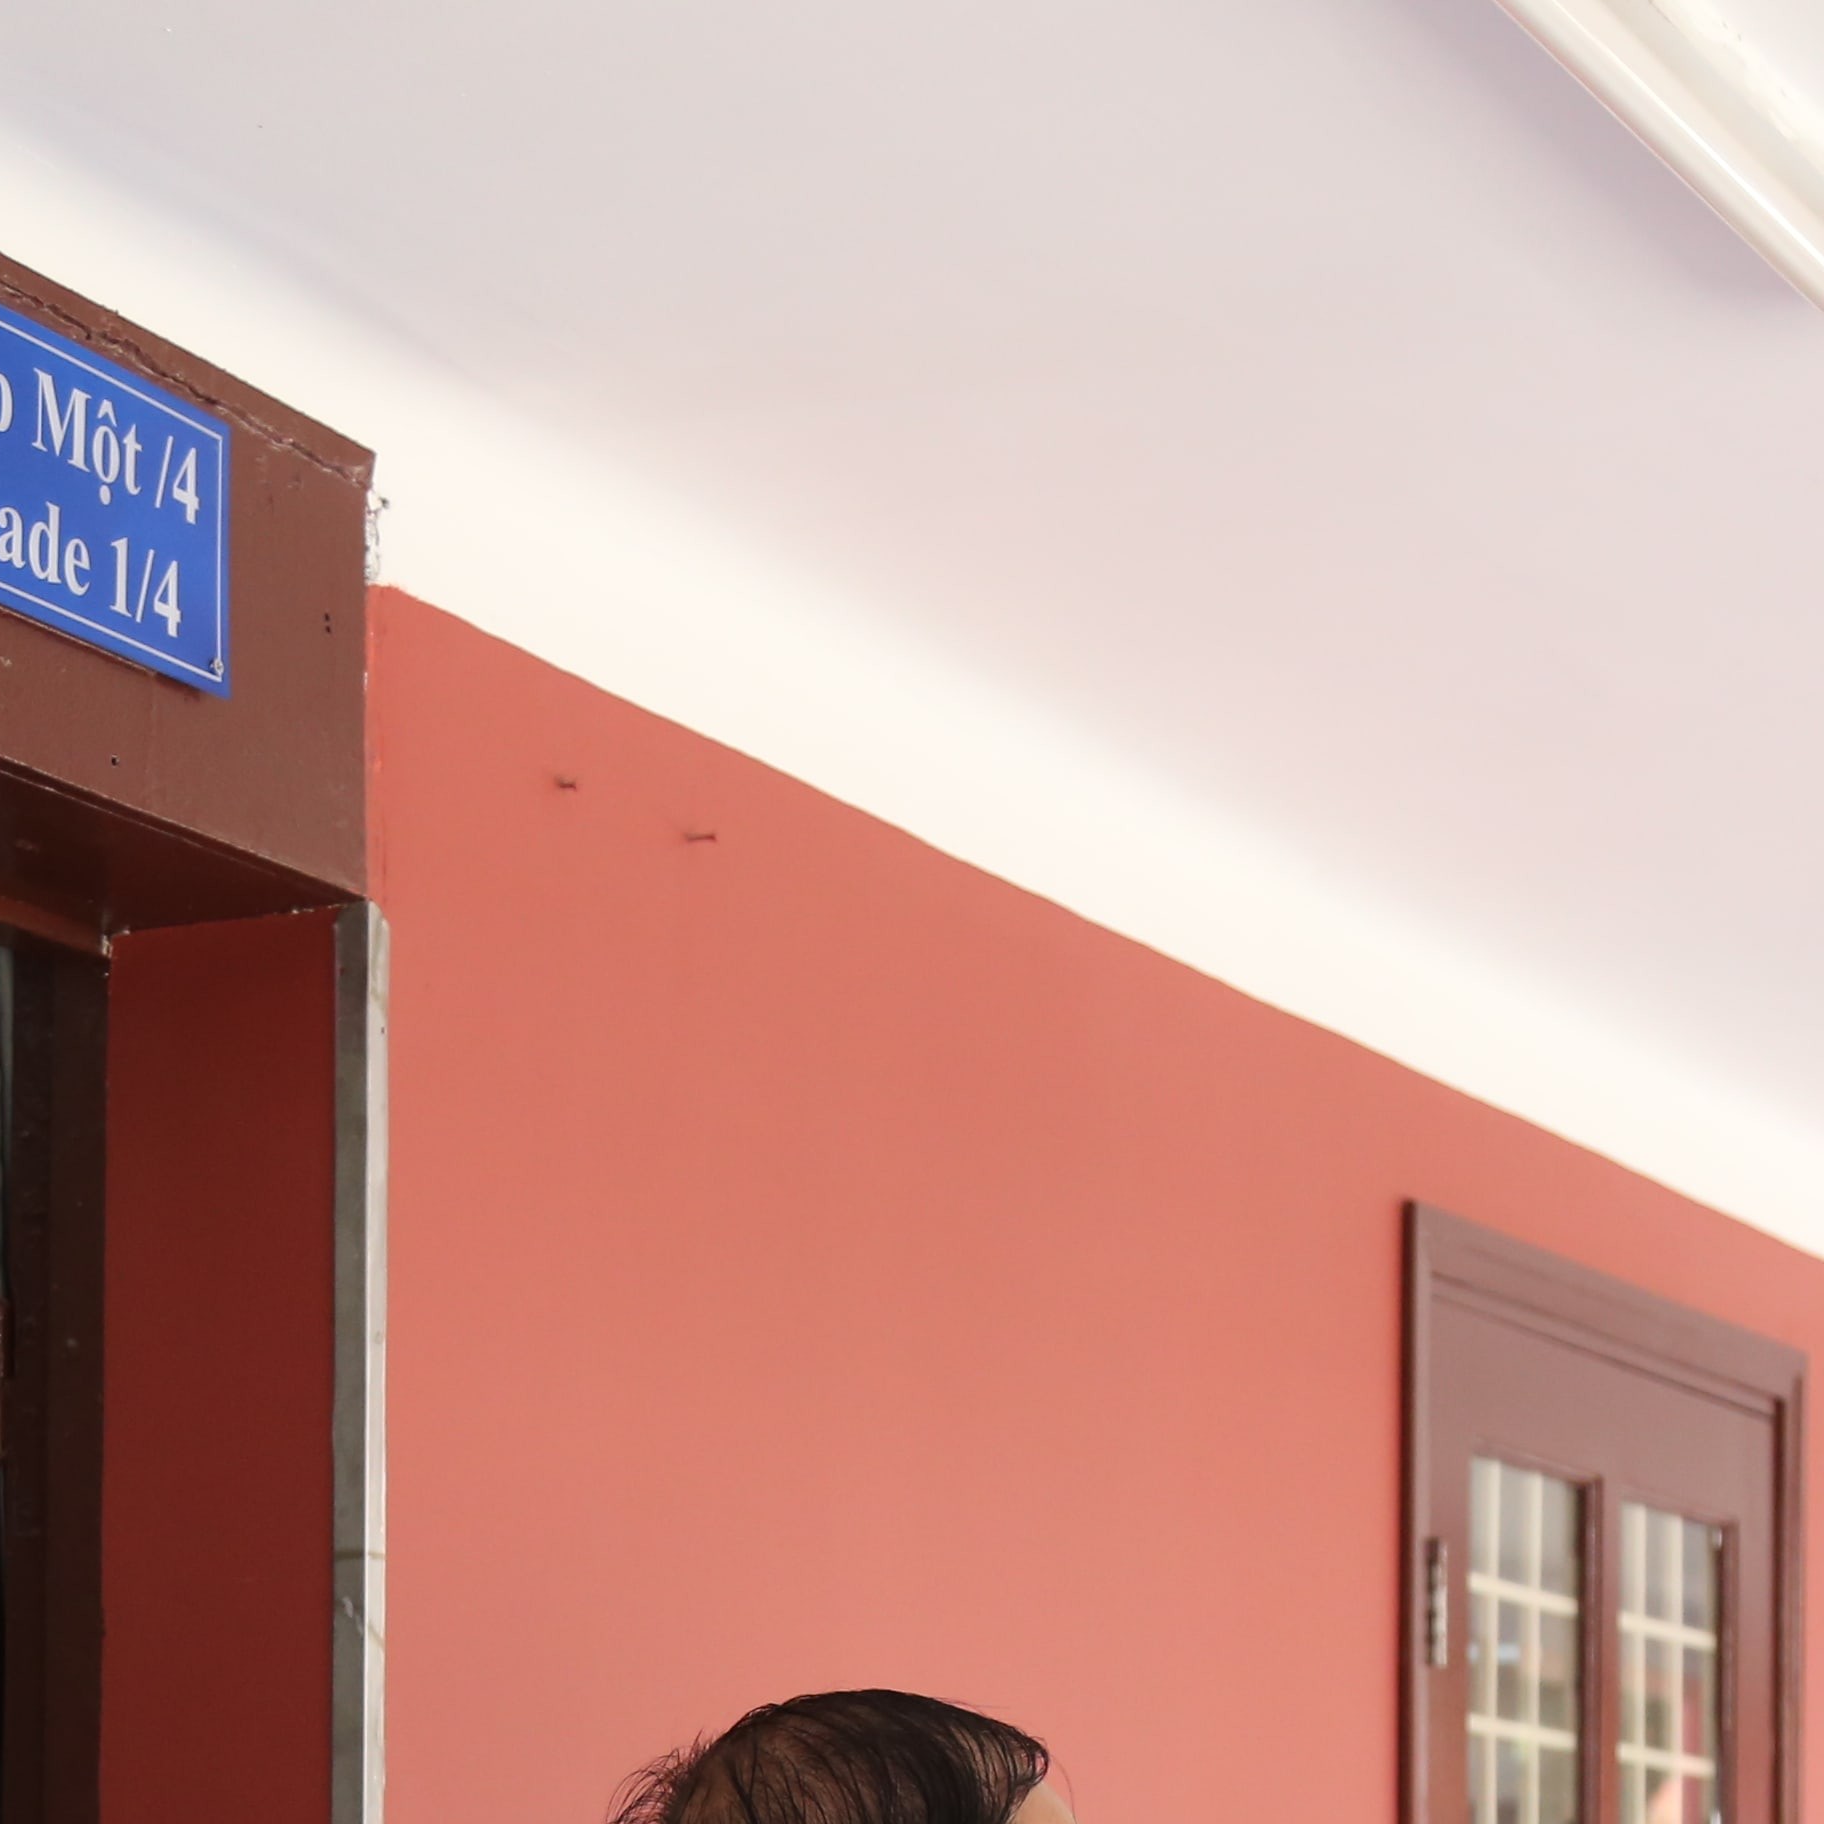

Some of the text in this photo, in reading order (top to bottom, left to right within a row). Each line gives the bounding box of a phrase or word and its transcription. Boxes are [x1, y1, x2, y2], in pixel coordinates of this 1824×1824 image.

[32, 367, 142, 505] Một
[155, 435, 200, 525] /4
[109, 536, 182, 638] 1/4
